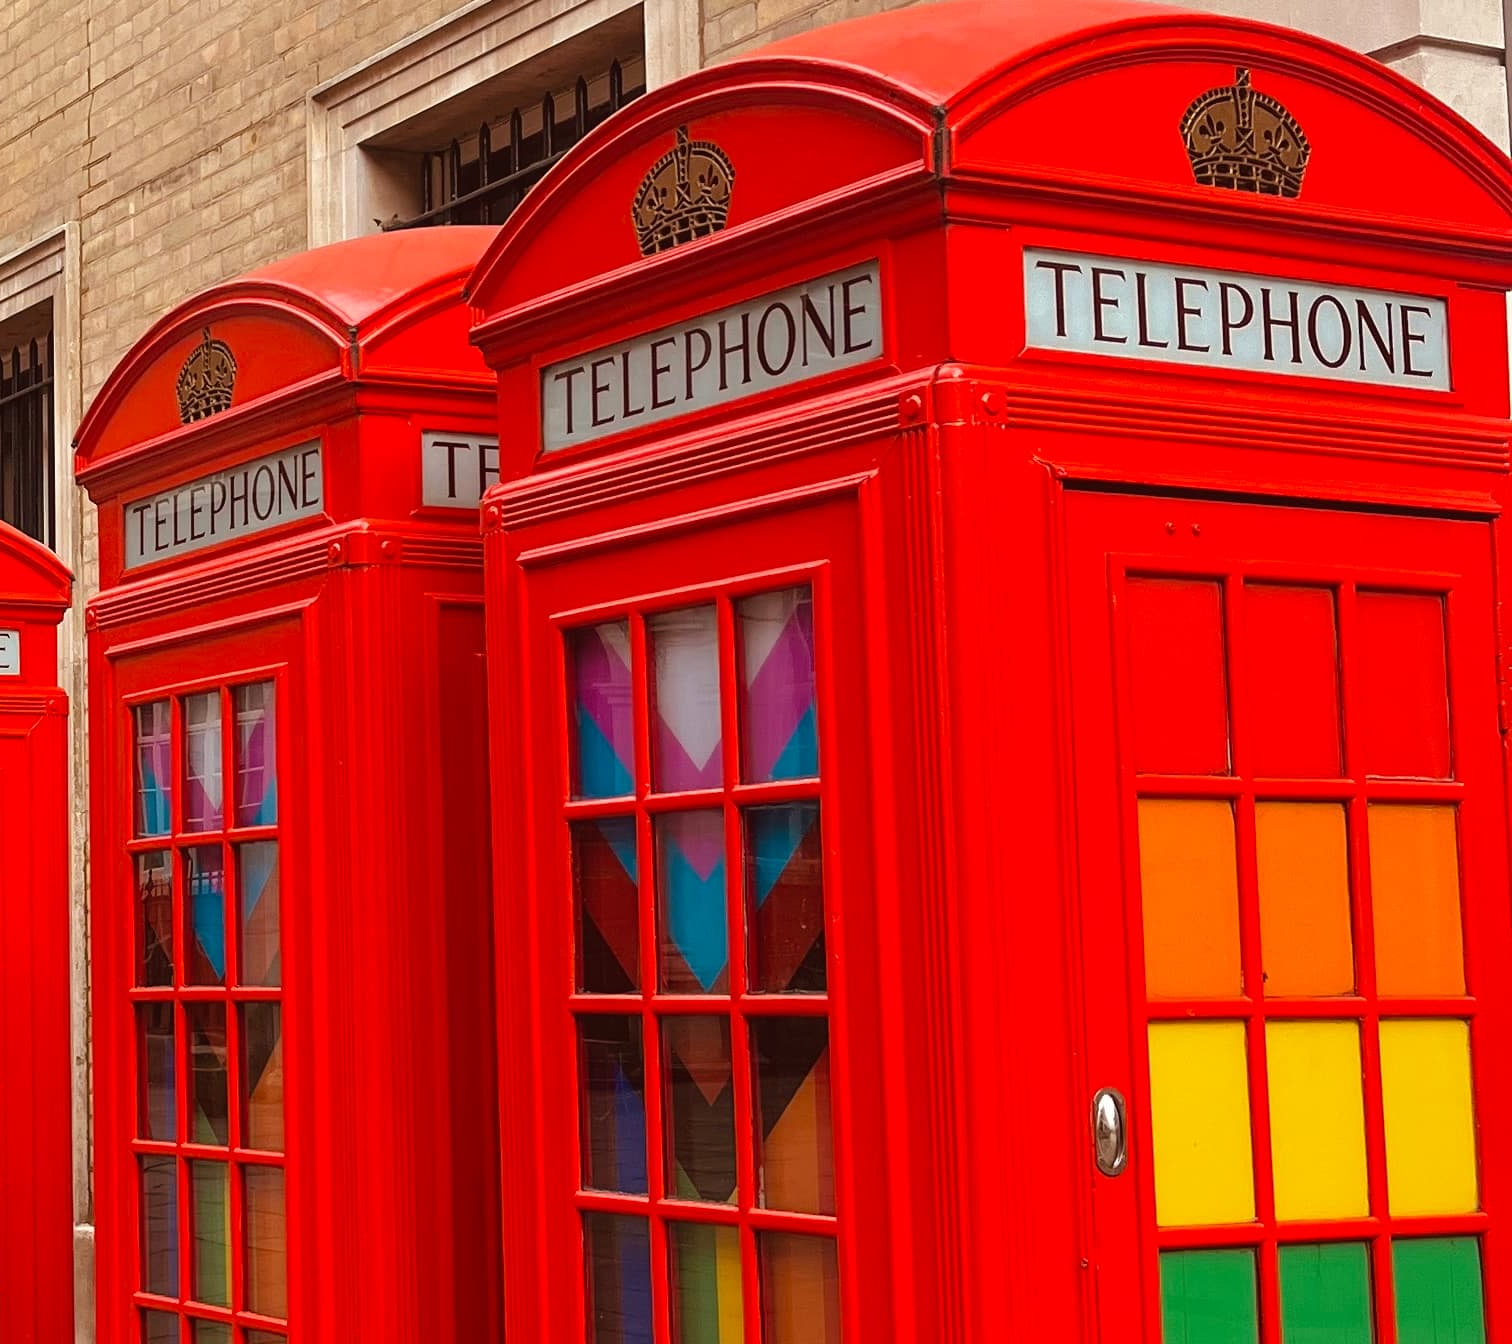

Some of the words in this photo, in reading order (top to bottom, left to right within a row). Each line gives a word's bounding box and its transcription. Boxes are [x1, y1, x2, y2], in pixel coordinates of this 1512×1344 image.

[553, 273, 873, 435] TELEPHONE
[1035, 260, 1434, 378] TELEPHONE
[133, 447, 319, 556] TELEPHONE
